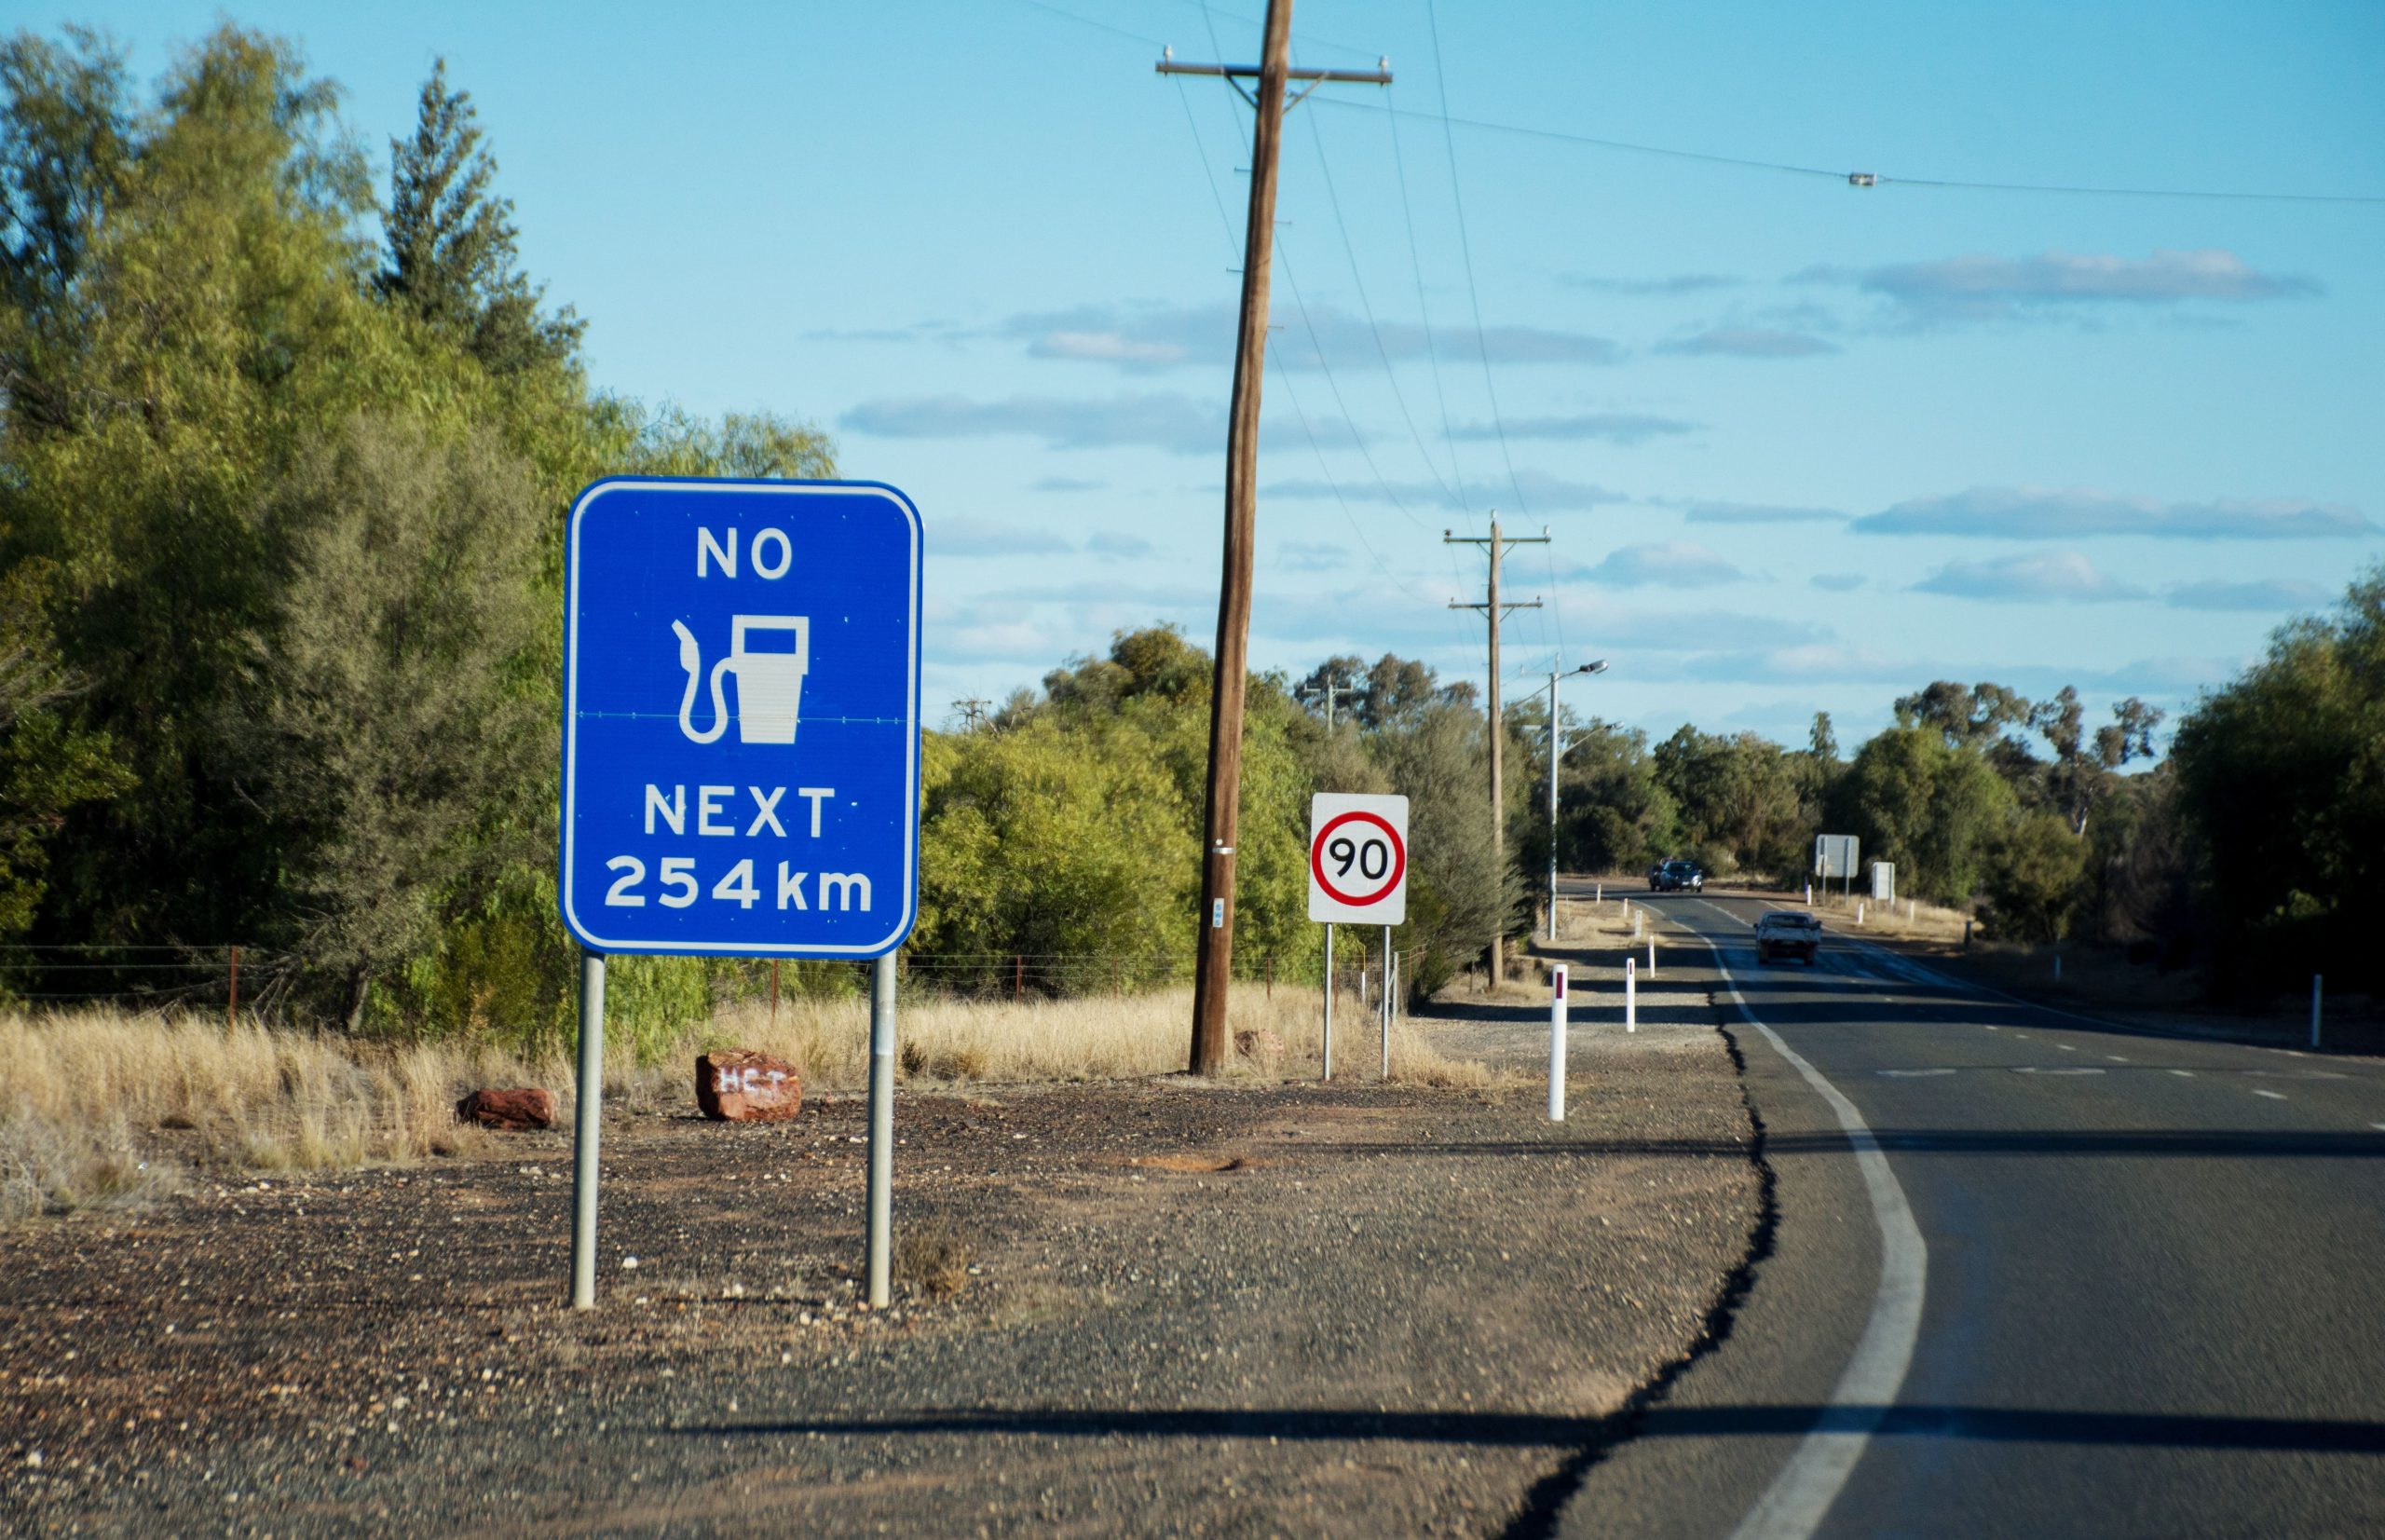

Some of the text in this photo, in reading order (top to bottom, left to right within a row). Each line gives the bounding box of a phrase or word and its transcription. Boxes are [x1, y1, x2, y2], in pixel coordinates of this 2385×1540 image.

[697, 526, 792, 579] NO
[645, 784, 836, 838] NEXT
[605, 855, 872, 912] 254 km
[1329, 837, 1388, 879] 90
